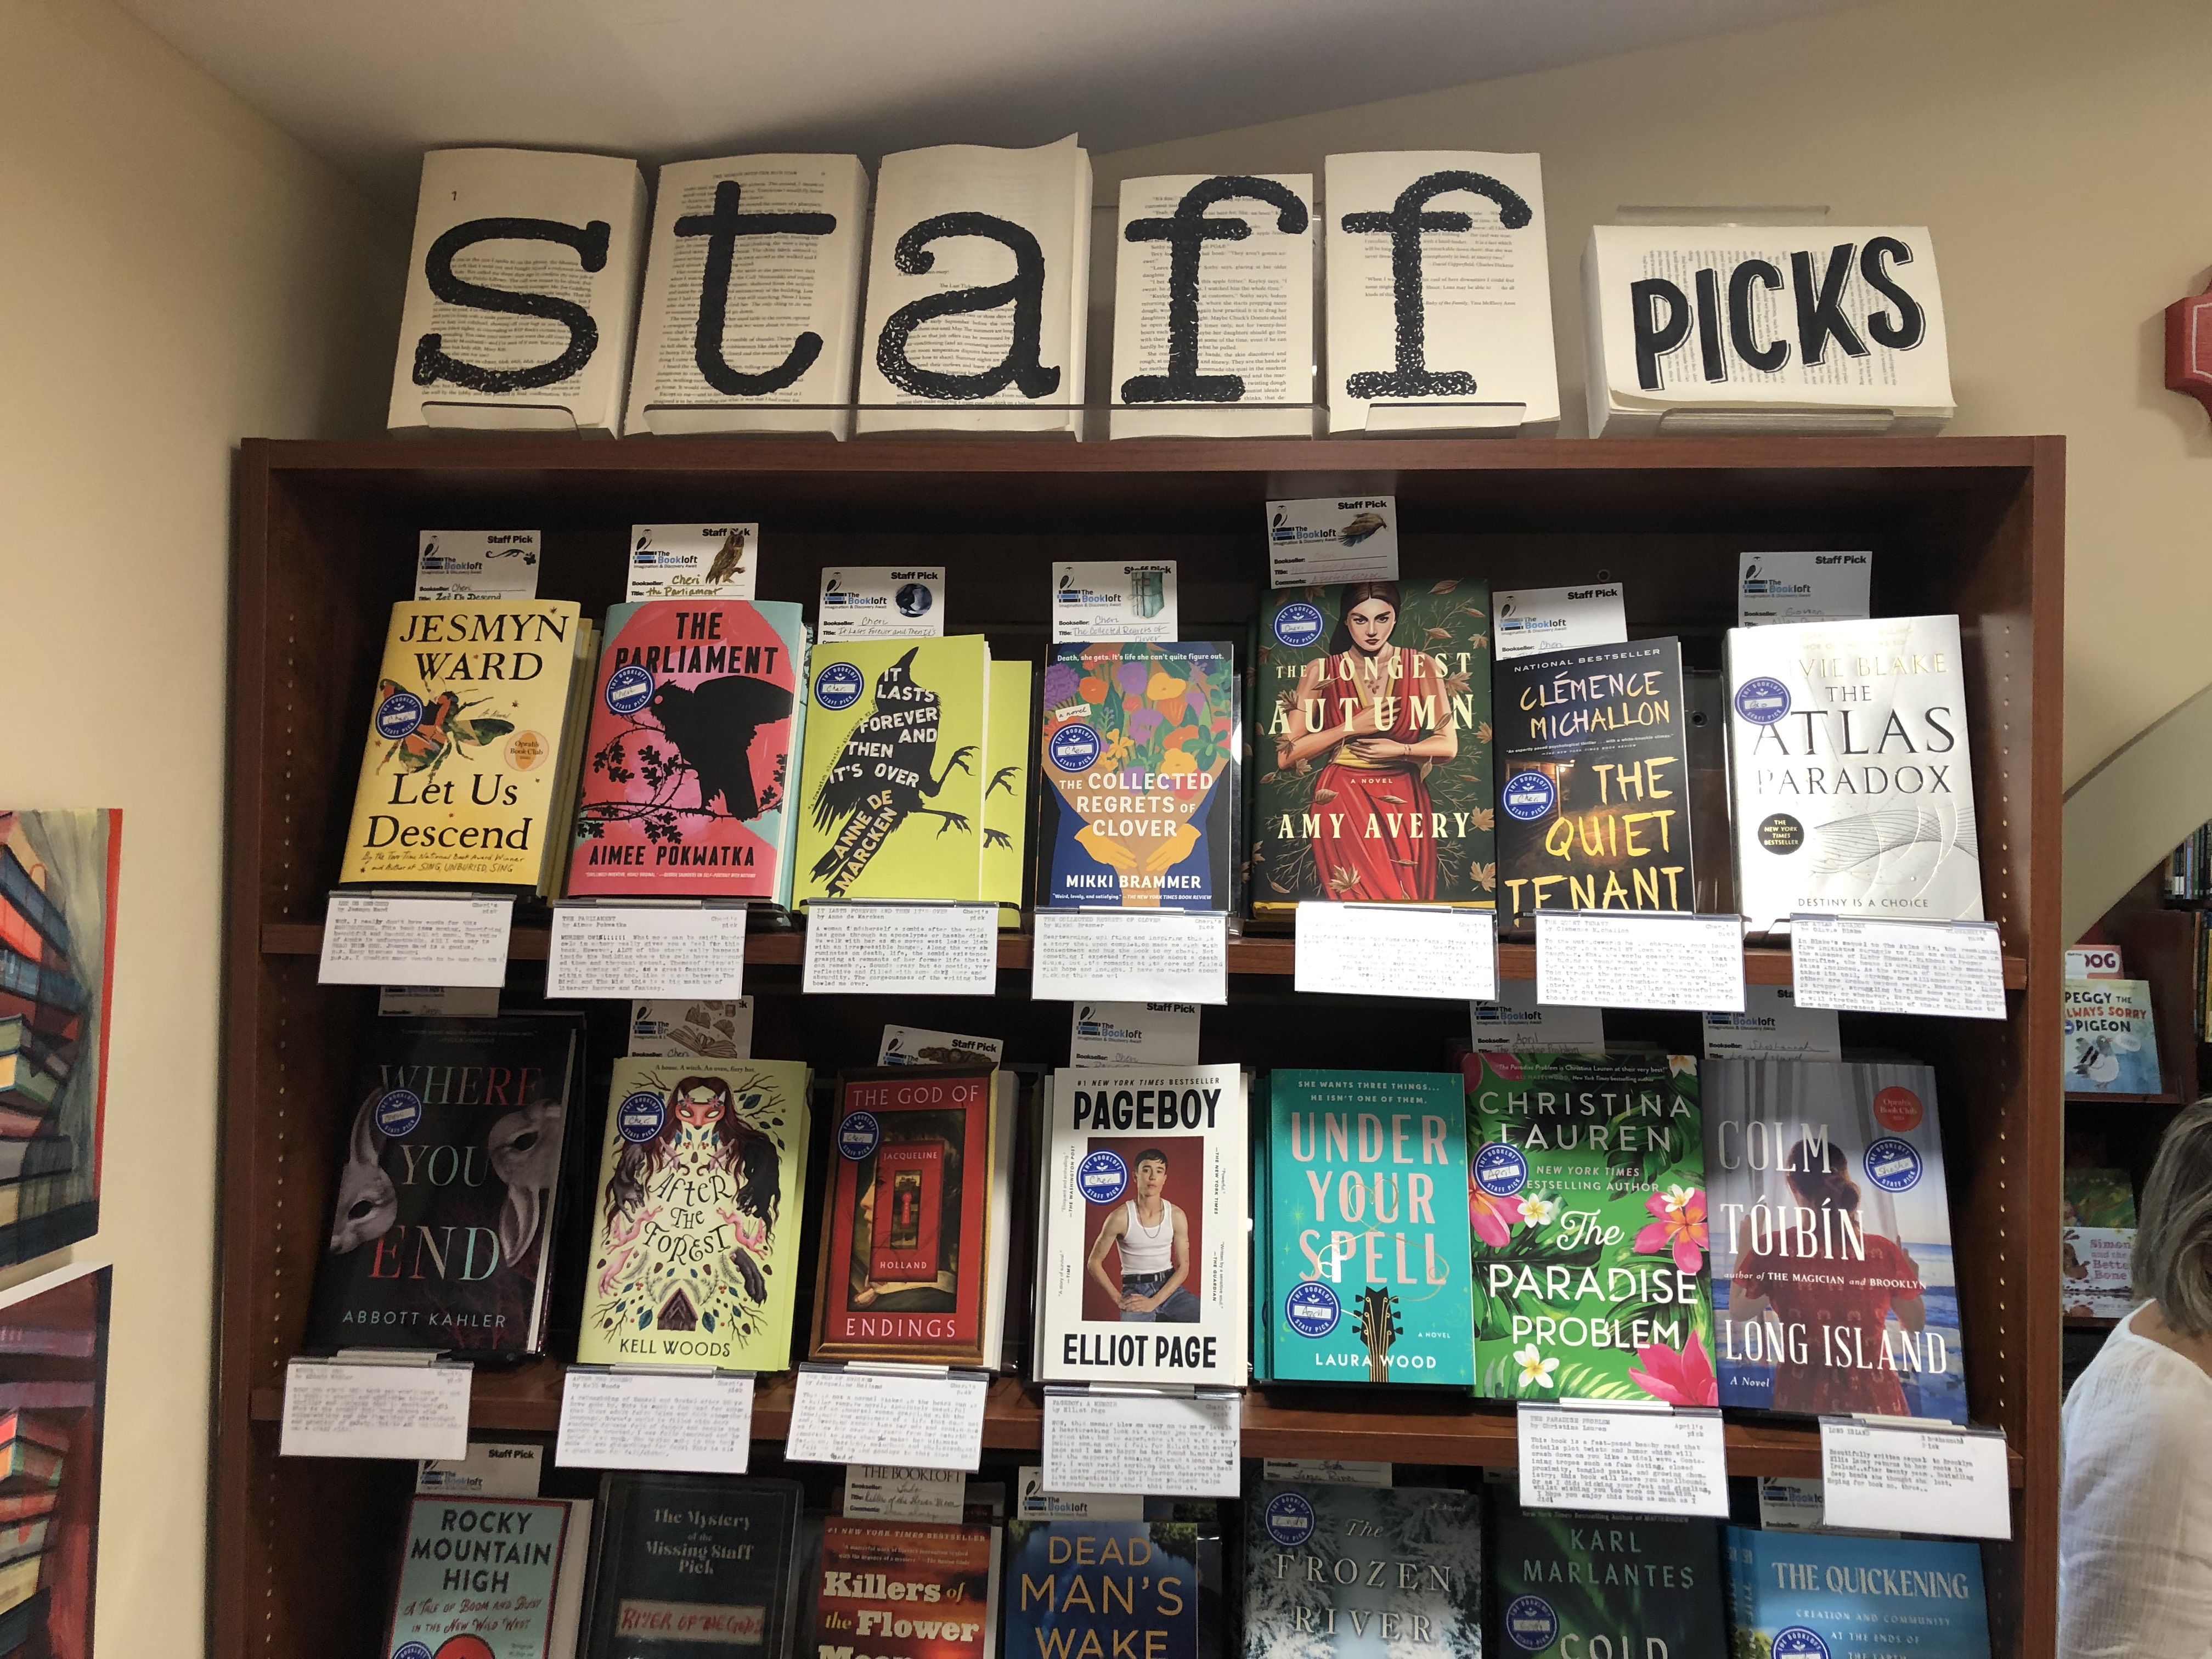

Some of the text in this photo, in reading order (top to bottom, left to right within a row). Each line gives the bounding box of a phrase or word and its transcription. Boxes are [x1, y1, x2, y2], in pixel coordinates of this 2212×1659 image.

[1630, 236, 1926, 391] PICKS
[1338, 500, 1387, 510] Staff Pick
[1296, 528, 1336, 539] Bookloft
[399, 613, 569, 644] JESMYN
[675, 612, 723, 640] THE
[414, 652, 543, 680] WARD
[614, 645, 778, 675] PARLIAMENT
[1170, 653, 1187, 661] quite
[1188, 652, 1209, 661] figure
[1276, 652, 1471, 681] THE LONGEST
[1514, 648, 1660, 673] NATIONAL BESTSELLER
[1857, 653, 1948, 677] BLAKE
[883, 668, 902, 682] IT
[877, 685, 934, 702] LASTS
[1520, 670, 1664, 711] CLÉMENCE
[1825, 686, 1871, 702] THE
[860, 707, 938, 734] FOREVER
[1268, 694, 1474, 735] AUTUMN
[1530, 700, 1670, 740] MICHALLON
[898, 729, 938, 743] AND
[1753, 707, 1955, 755] ATLAS
[847, 741, 893, 758] THEN
[388, 773, 517, 805] Let Us
[830, 763, 919, 788] IT'S OVER
[1059, 772, 1213, 790] THE COLLECTED
[1592, 757, 1679, 805] THE
[1758, 765, 1953, 794] PARADOX
[1077, 796, 1196, 814] REGRETS OF
[363, 815, 533, 850] Descend
[833, 790, 893, 859] ANNE DE
[1093, 820, 1177, 837] CLOVER
[1278, 812, 1470, 839] AMY AVERY
[1545, 810, 1675, 861] QUIET
[589, 845, 754, 866] AIMEE POKWATKA
[835, 807, 897, 890] MARCKEN
[1066, 875, 1201, 888] MIKKI BRAMMER
[1505, 867, 1685, 913] TENANT
[1798, 898, 1929, 907] DESTINY IS A CHOICE
[2065, 991, 2112, 1004] PEGGY
[2067, 1007, 2147, 1019] LWAYS SORRY
[2075, 1019, 2131, 1032] PIGEON
[379, 1065, 543, 1105] WHERE
[854, 1085, 979, 1106] THE GOD OF
[1169, 1077, 1220, 1086] BESTSELLER
[1073, 1088, 1222, 1130] PAGEBOY
[1479, 1092, 1690, 1118] CHRISTINA
[1291, 1112, 1448, 1165] UNDER
[1502, 1123, 1671, 1152] LAUREN
[1718, 1120, 1832, 1174] COLM
[399, 1144, 490, 1187] YOU
[883, 1152, 937, 1161] JACQUELINE
[1537, 1166, 1639, 1176] NEW YORK TIMES
[1306, 1170, 1436, 1223] YOUR
[1527, 1181, 1659, 1192] ESTSELLING AUTHOR
[1556, 1209, 1625, 1250] The
[1720, 1194, 1866, 1262] TÓIBÍN
[368, 1225, 499, 1281] END
[1299, 1229, 1447, 1284] SPELL
[2090, 1239, 2131, 1249] Simon
[1489, 1264, 1698, 1304] PARADISE
[1756, 1272, 1765, 1281] of
[1768, 1272, 1788, 1282] THE
[1792, 1273, 1844, 1284] MAGICIAN
[1849, 1278, 1866, 1286] and
[1870, 1278, 1927, 1290] BROOKLYN
[342, 1311, 506, 1328] ABBOTT KAHLER
[846, 1318, 956, 1338] ENDINGS
[1512, 1315, 1680, 1350] PROBLEM
[619, 1338, 730, 1357] KELL WOODS
[1063, 1333, 1217, 1368] ELLIOT PAGE
[1316, 1353, 1436, 1368] LAURA WOOD
[1725, 1319, 1947, 1374] LONG ISLAND
[1730, 1376, 1770, 1387] A Novel
[441, 1509, 533, 1534] ROCKY
[1345, 1519, 1384, 1537] The
[410, 1537, 552, 1566] MOUNTAIN
[1049, 1536, 1151, 1566] DEAD
[1571, 1528, 1641, 1553] KARL
[442, 1568, 510, 1593] HIGH
[1275, 1553, 1452, 1592] FROZEN
[1523, 1559, 1694, 1589] MARLANTES
[1771, 1562, 1969, 1599] THE QUICKENING
[823, 1571, 966, 1604] Killers of
[1021, 1574, 1183, 1616] MAN'S
[825, 1610, 979, 1642] the Flower
[1295, 1606, 1431, 1643] RIVER
[1035, 1627, 1168, 1659] WAKE
